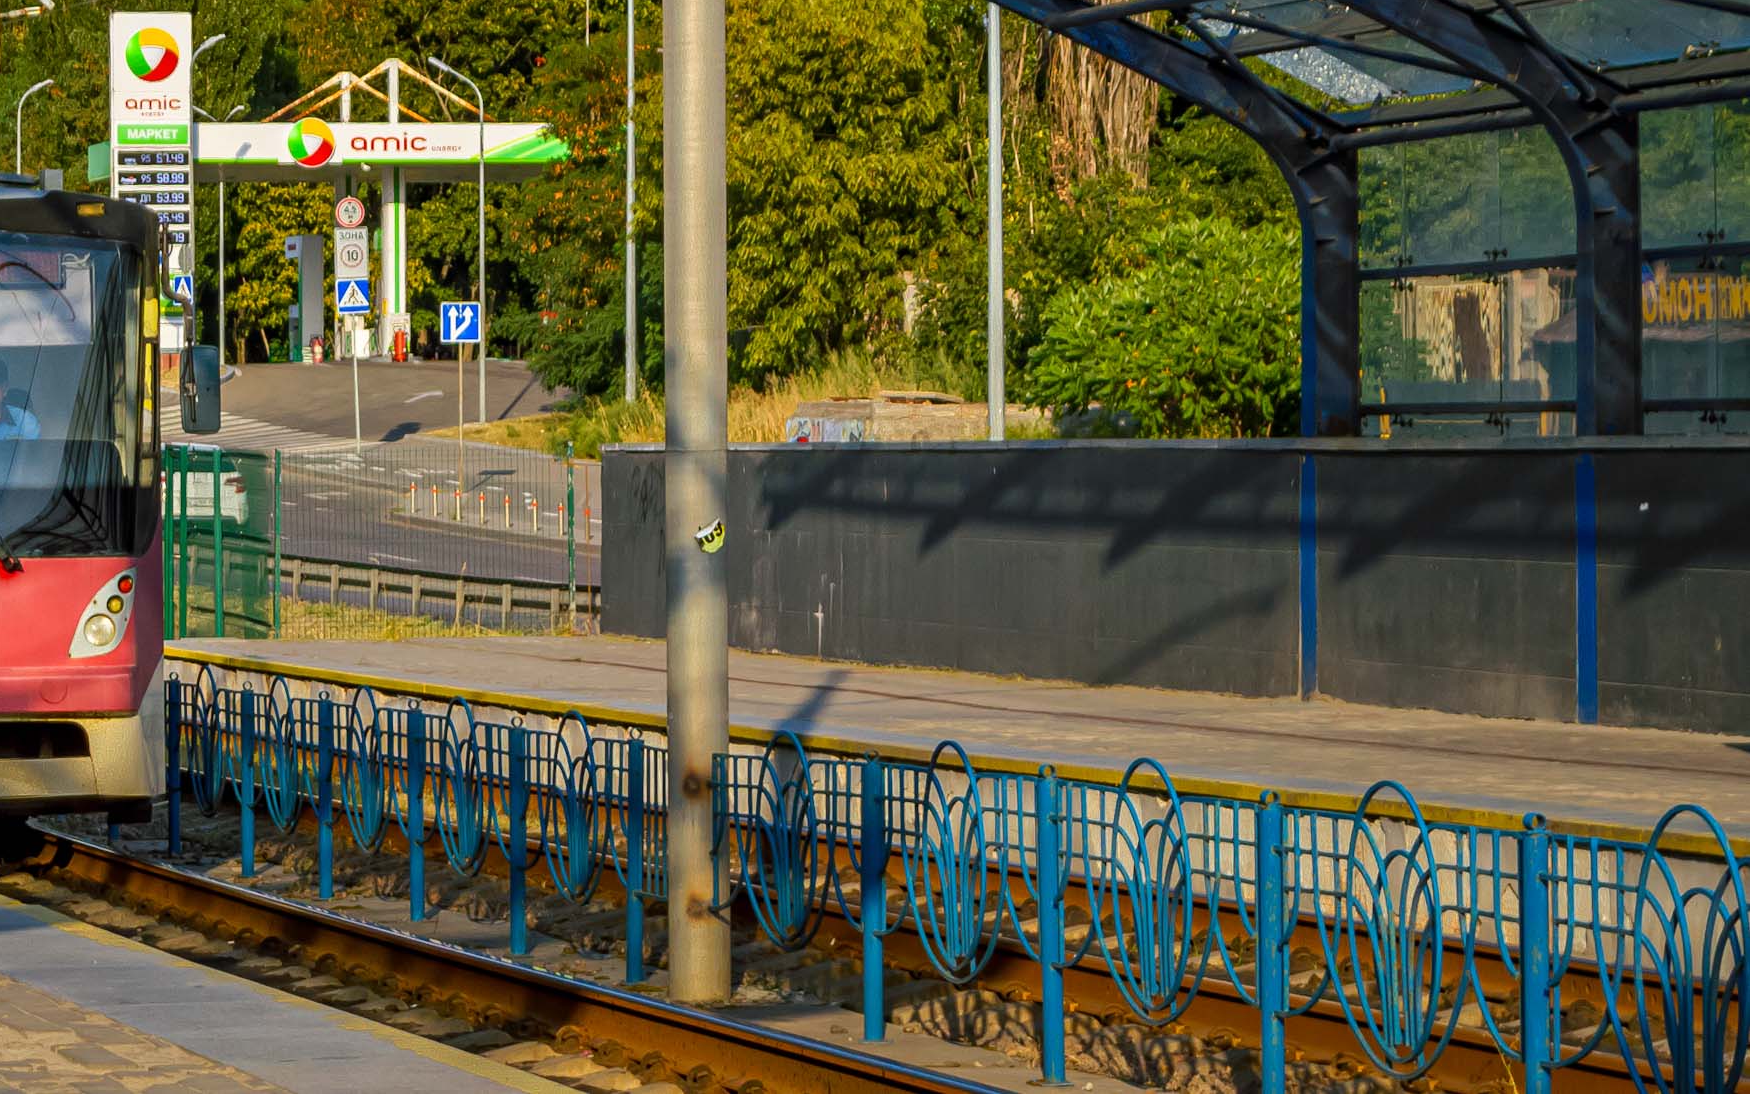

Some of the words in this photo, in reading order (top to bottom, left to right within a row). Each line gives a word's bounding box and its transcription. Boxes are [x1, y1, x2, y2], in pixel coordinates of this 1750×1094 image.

[125, 95, 181, 110] amic
[127, 128, 178, 139] МАРКЕТ
[350, 131, 427, 151] amic
[140, 173, 151, 183] 95
[338, 231, 365, 240] ЗОНА
[347, 250, 358, 261] 10
